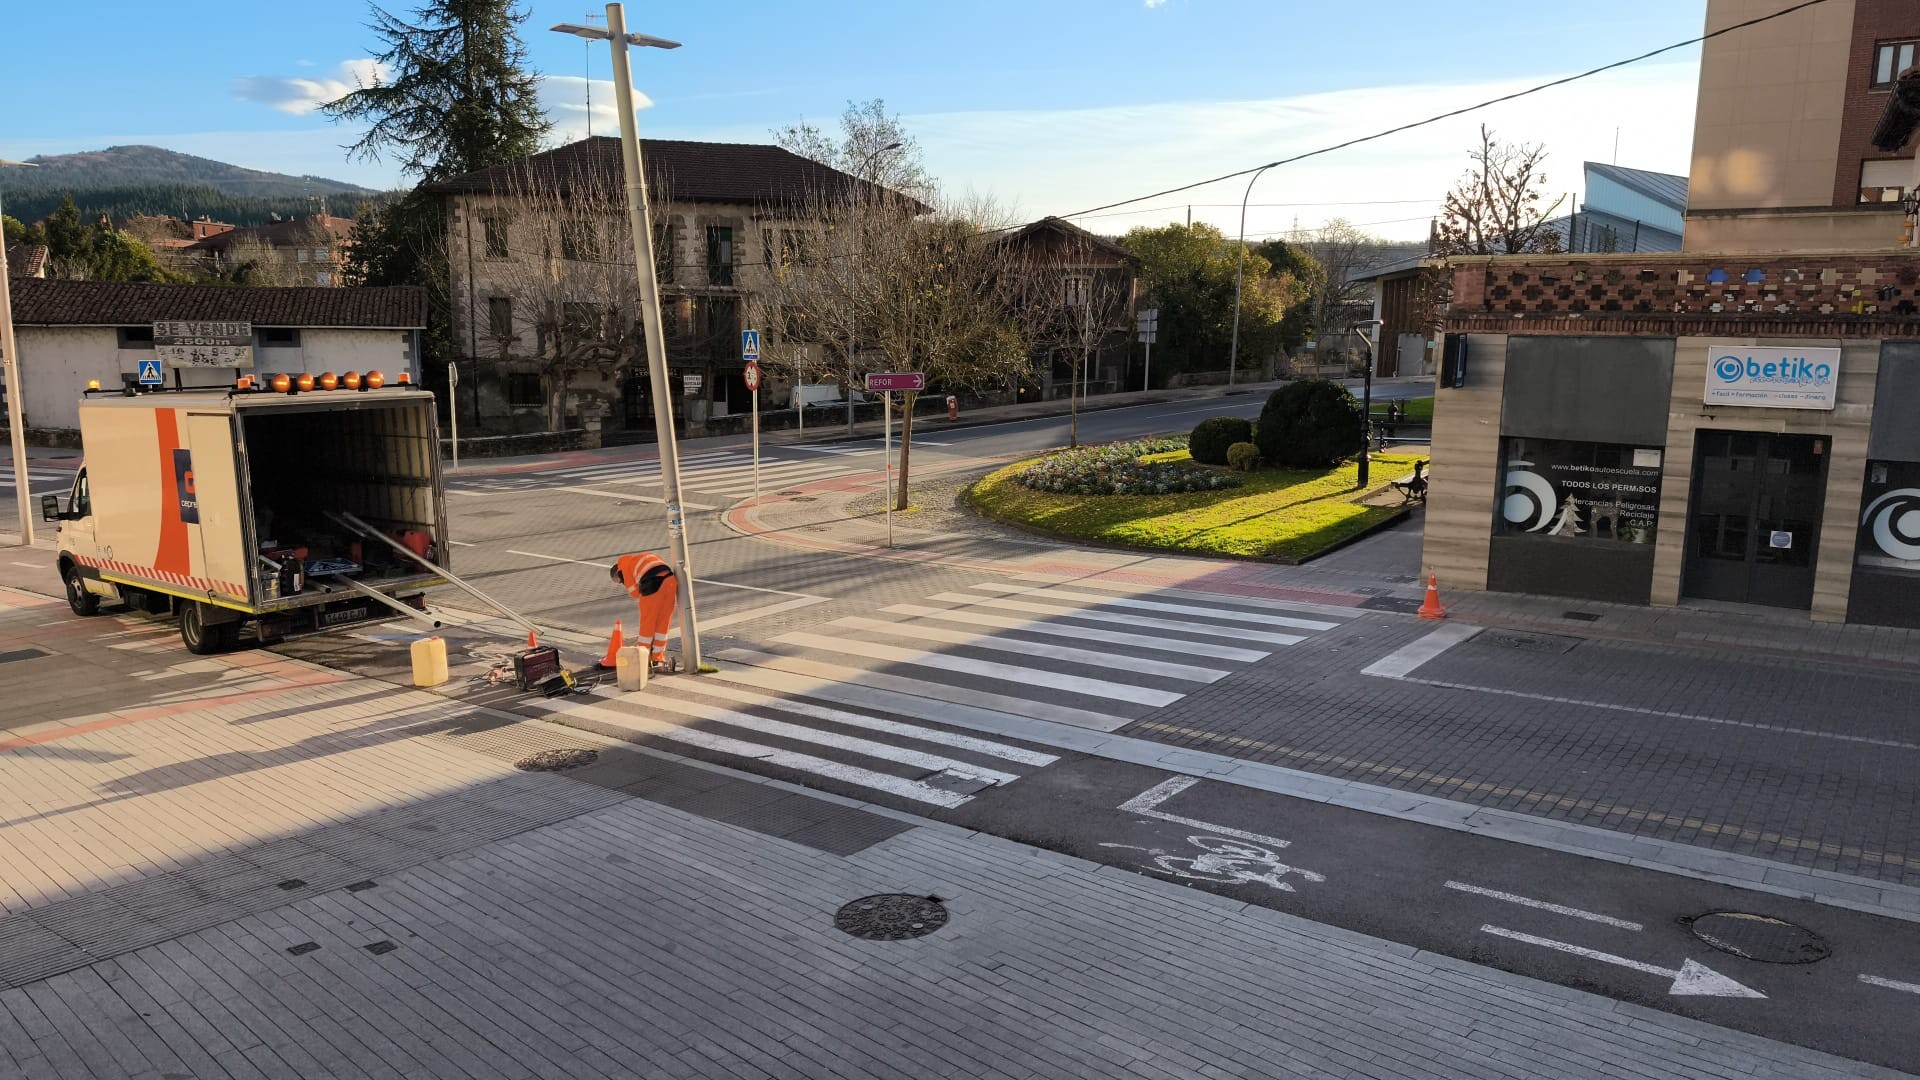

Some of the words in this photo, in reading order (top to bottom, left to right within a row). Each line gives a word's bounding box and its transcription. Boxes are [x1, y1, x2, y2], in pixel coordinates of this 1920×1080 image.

[156, 322, 179, 336] SE
[186, 322, 250, 336] VENDE
[1746, 356, 1830, 378] betiko
[1552, 464, 1658, 476] www.betikoautoescuela.com
[1562, 480, 1590, 489] TODOS
[1616, 501, 1655, 511] Peligrosas
[1620, 510, 1654, 520] Reciclaje
